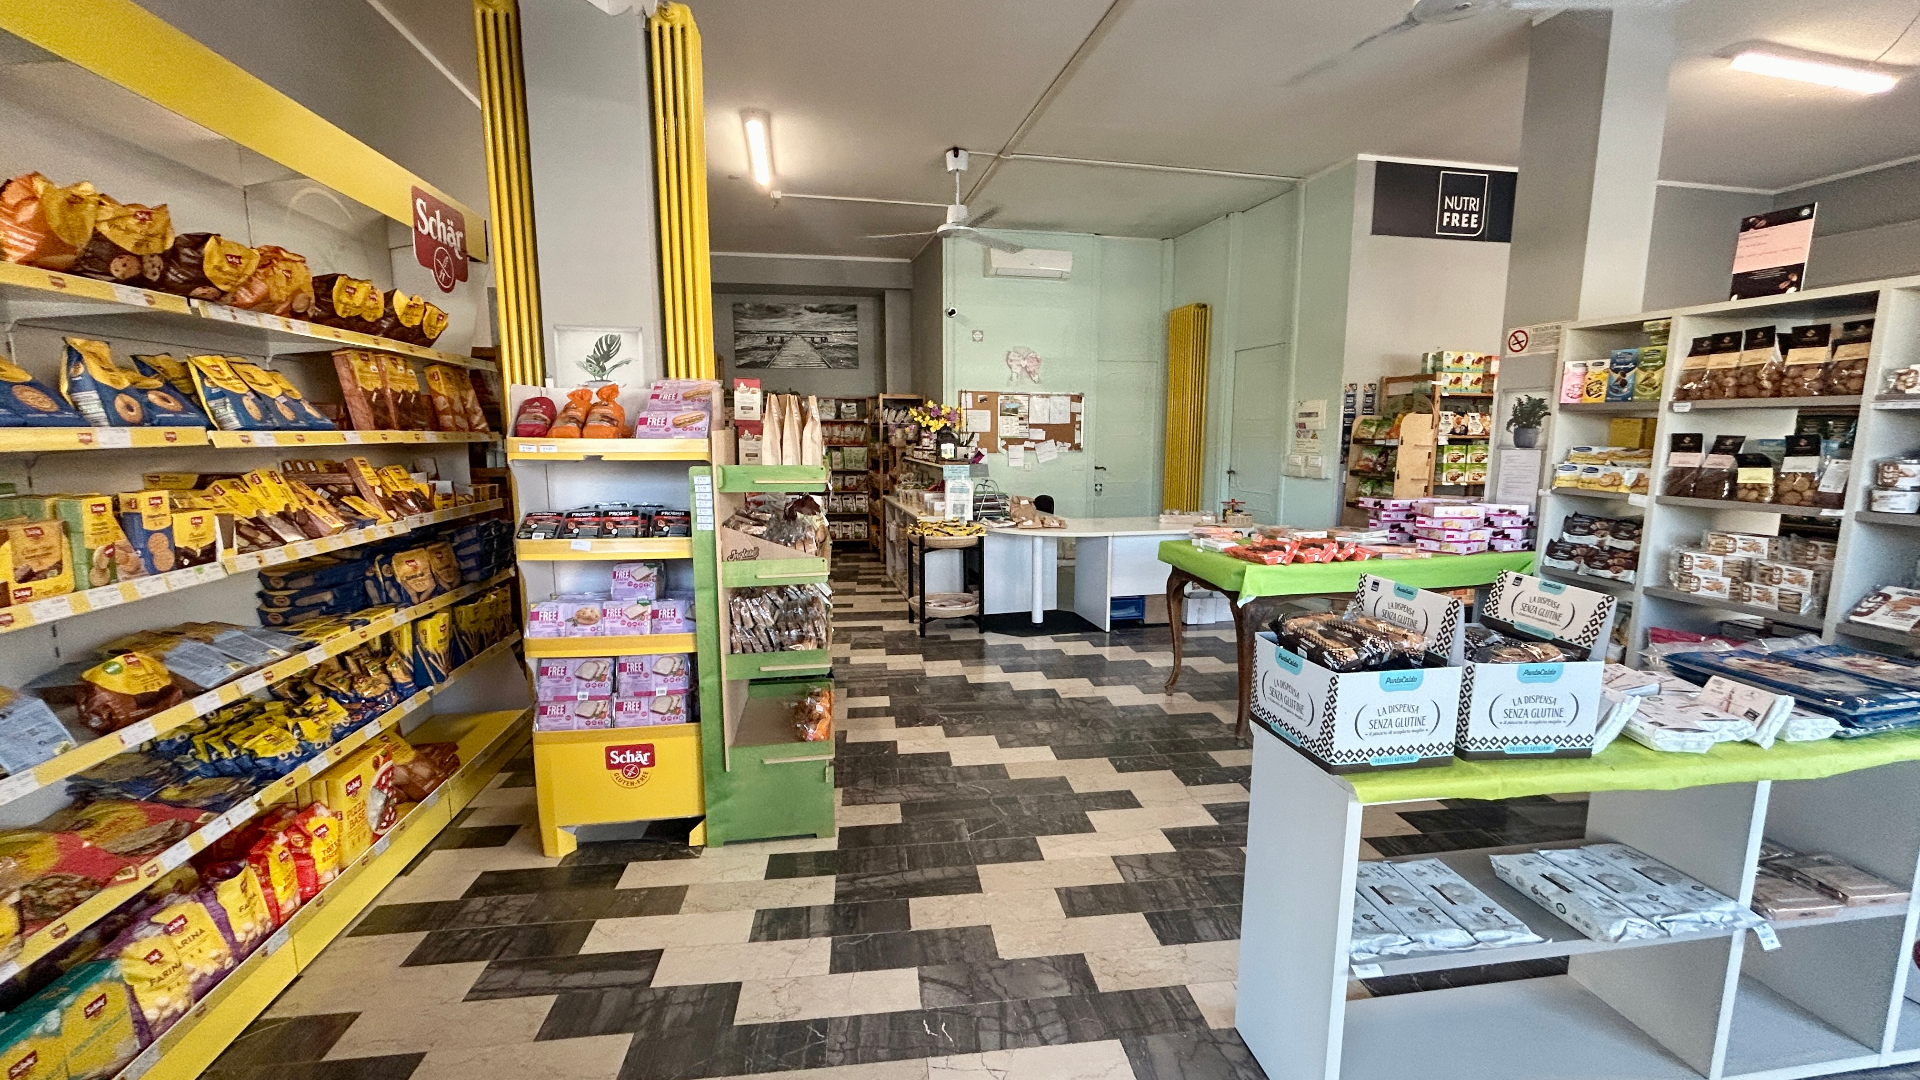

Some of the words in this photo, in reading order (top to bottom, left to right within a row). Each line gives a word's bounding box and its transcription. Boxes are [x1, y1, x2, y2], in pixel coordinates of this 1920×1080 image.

[1444, 195, 1480, 212] NUTRI
[1442, 212, 1479, 228] FREE
[415, 198, 464, 260] Schär
[646, 417, 667, 426] FREE
[615, 570, 630, 579] FREE
[1395, 602, 1415, 617] DISPENSA
[1537, 597, 1561, 610] DISPENSA
[539, 611, 558, 621] FREE
[606, 608, 623, 618] FREE
[658, 608, 676, 619] FREE
[1520, 603, 1538, 614] SENZA
[1538, 608, 1564, 622] GLUTINE
[1382, 609, 1397, 621] SENZA
[1397, 615, 1419, 629] GLUTINE
[547, 666, 566, 677] FREE
[626, 662, 642, 673] FREE
[1385, 676, 1417, 684] PuntoCaldo
[1273, 679, 1280, 688] LA
[1280, 680, 1300, 700] DISPENSA
[622, 701, 640, 712] FREE
[1269, 686, 1283, 701] SENZA
[1283, 695, 1305, 716] GLUTINE
[1512, 697, 1522, 706] LA
[1524, 695, 1557, 706] DISPENSA
[546, 704, 565, 715] FREE
[1377, 707, 1387, 716] LA
[1388, 704, 1420, 714] DISPENSA
[1503, 708, 1529, 719] SENZA
[1531, 707, 1565, 718] GLUTINE
[1368, 718, 1393, 729] SENZA
[1395, 716, 1427, 728] GLUTINE
[610, 750, 651, 765] Schär
[613, 770, 649, 787] GLUTEN-FREE
